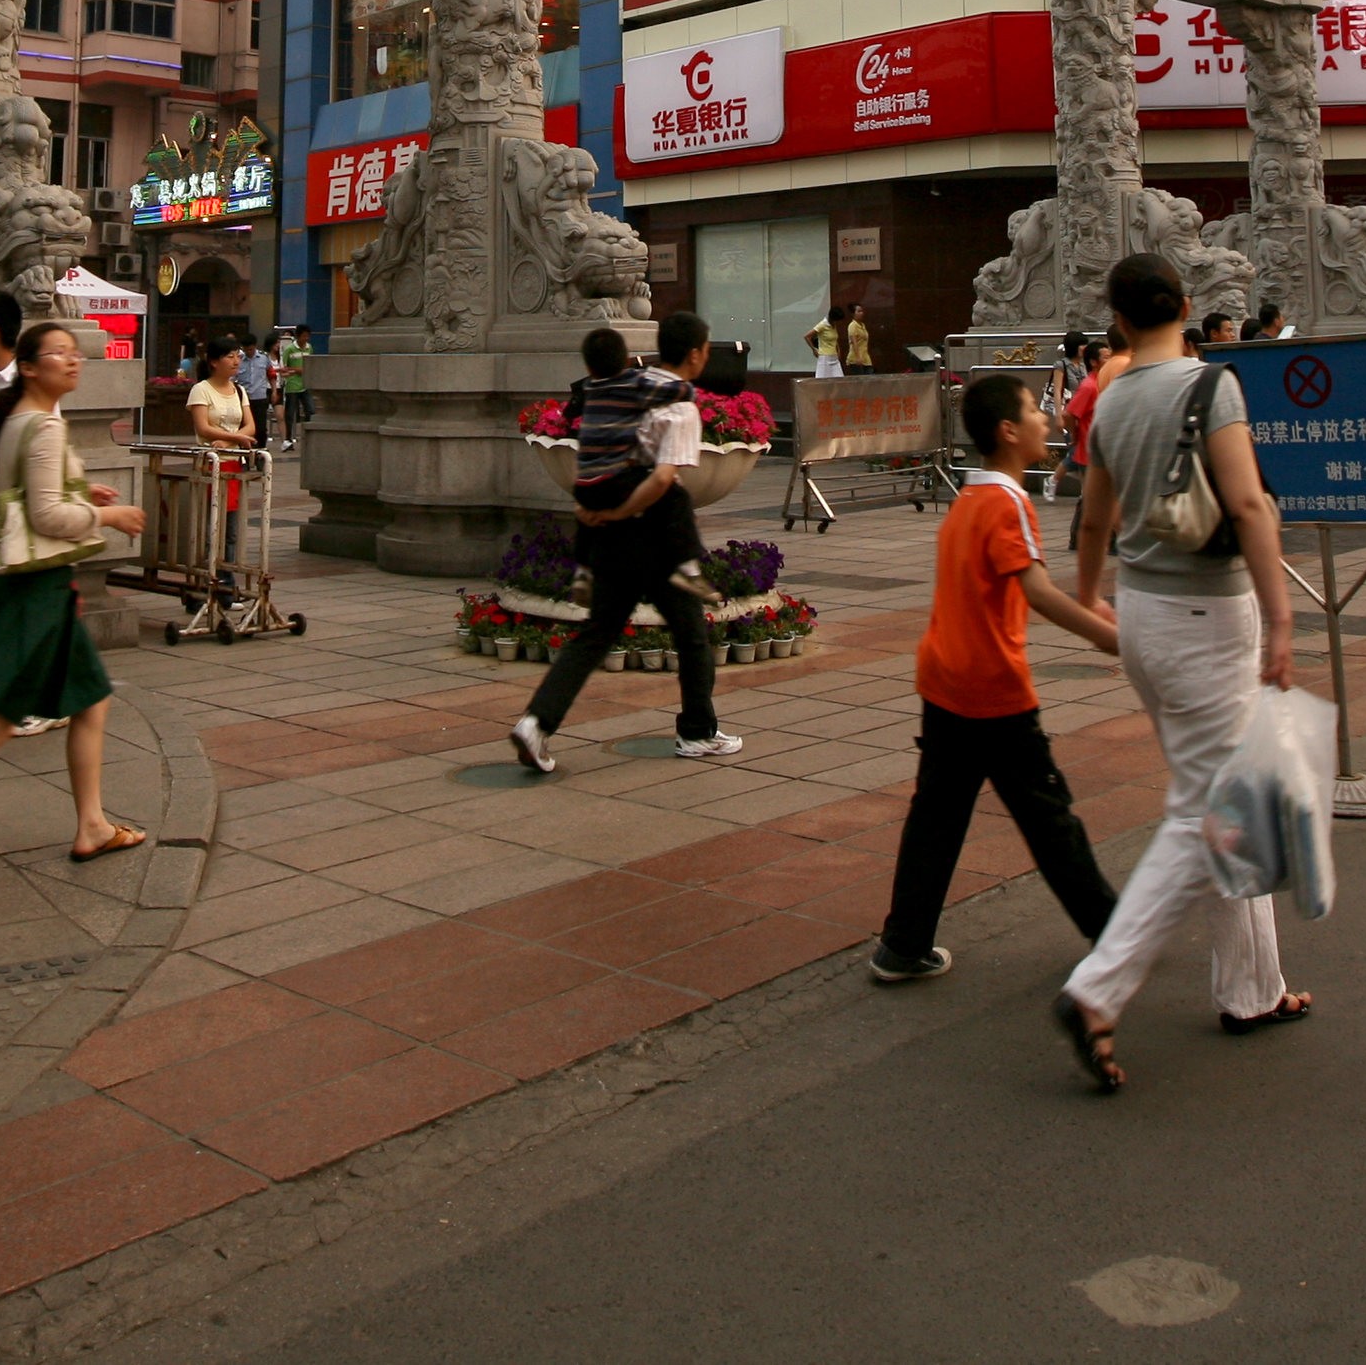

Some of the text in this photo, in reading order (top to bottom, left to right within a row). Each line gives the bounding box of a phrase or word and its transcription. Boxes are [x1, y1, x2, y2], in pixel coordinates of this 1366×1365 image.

[894, 46, 911, 60] 小时
[865, 52, 891, 80] 24
[891, 66, 913, 76] Hour
[1195, 58, 1246, 75] HU
[856, 89, 930, 118] 自助银行服务
[652, 97, 748, 138] 华夏银行
[654, 128, 749, 152] HUA XIA BANK
